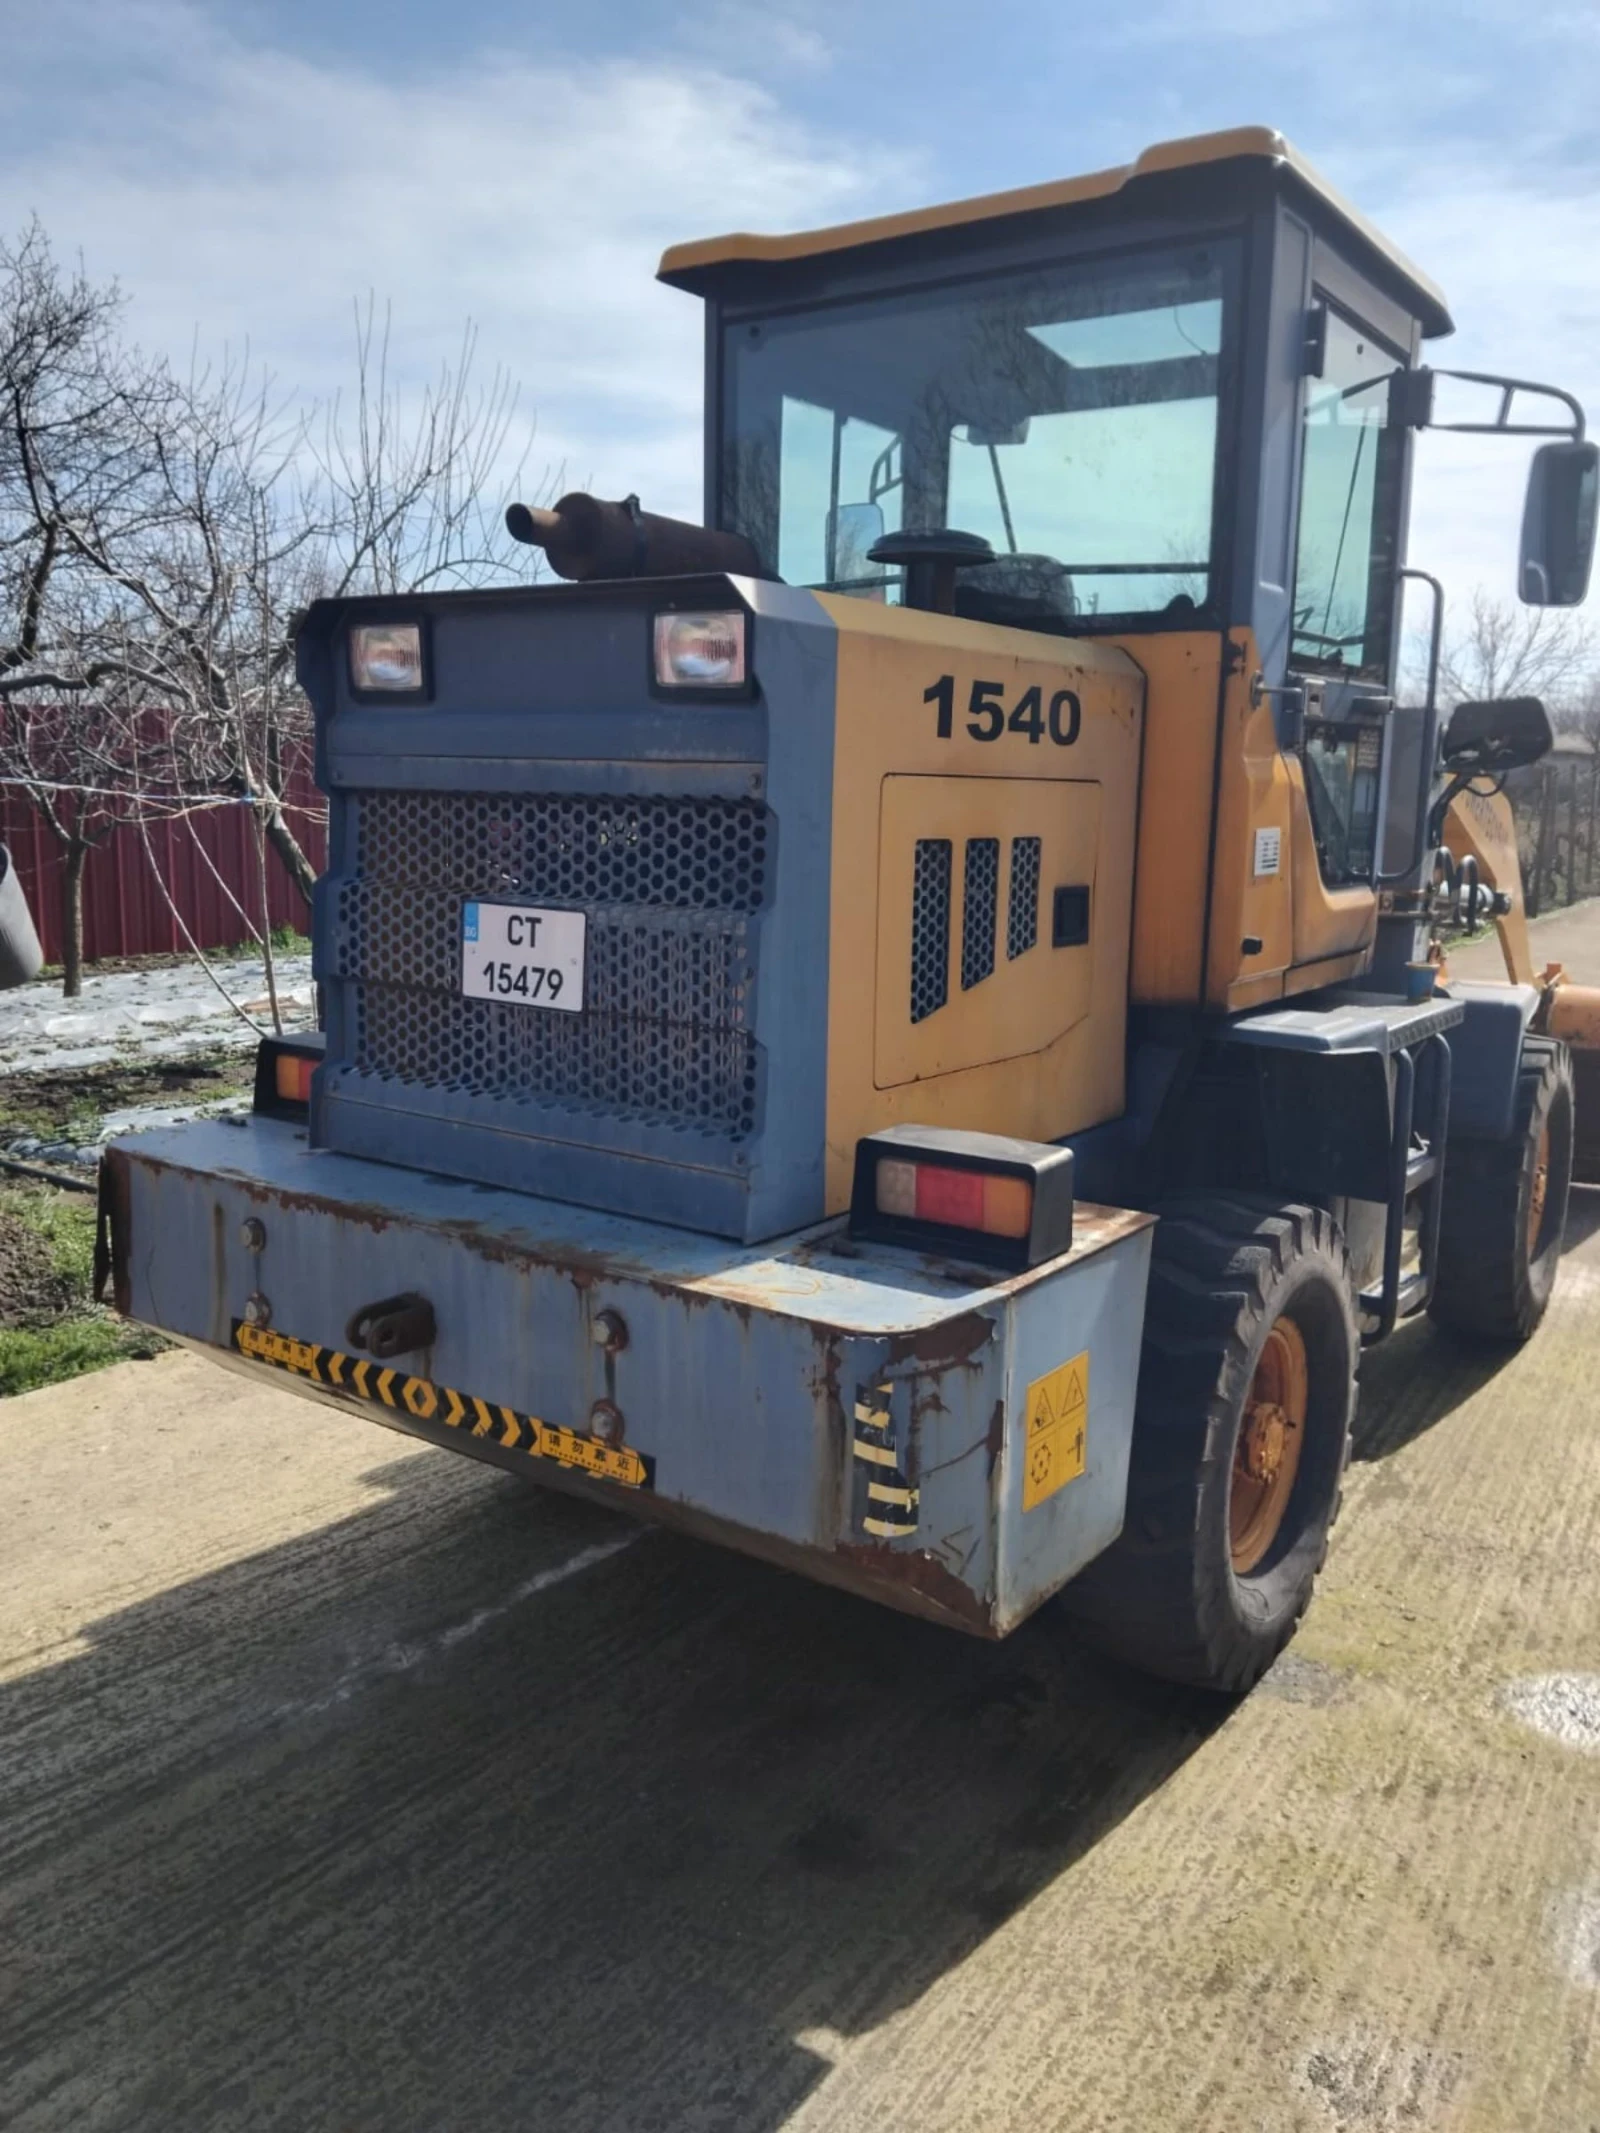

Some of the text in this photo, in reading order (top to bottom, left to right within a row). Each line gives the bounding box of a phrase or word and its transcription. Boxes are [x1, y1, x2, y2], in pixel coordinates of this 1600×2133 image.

[923, 674, 1081, 746] 1540
[507, 914, 542, 948] CT
[482, 960, 564, 1000] 15479
